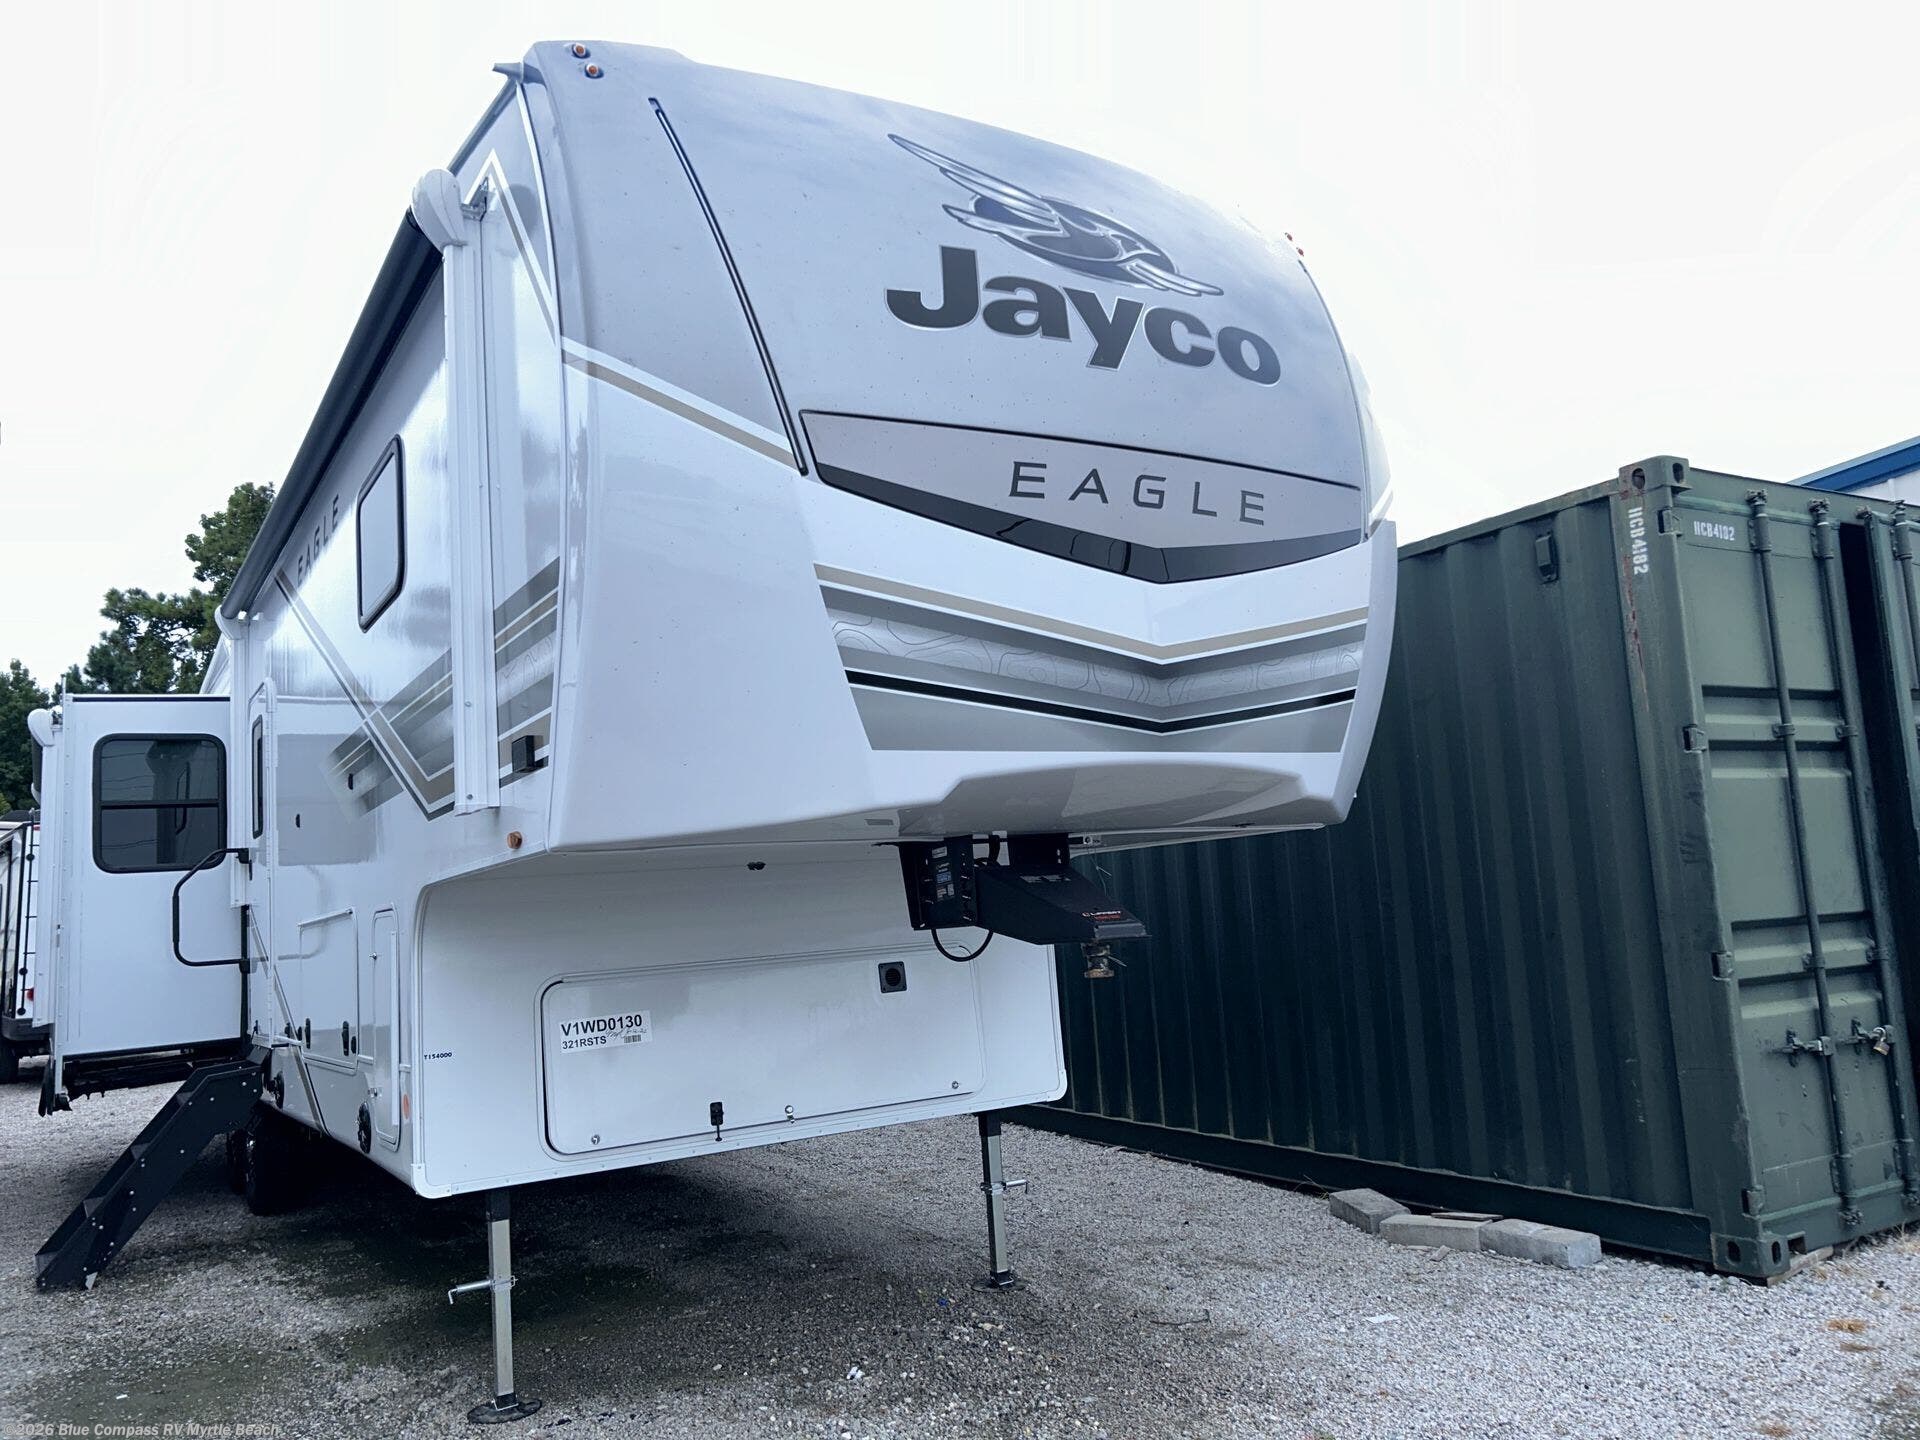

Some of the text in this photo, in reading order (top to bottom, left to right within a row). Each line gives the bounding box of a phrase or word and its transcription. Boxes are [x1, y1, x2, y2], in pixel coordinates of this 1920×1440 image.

[885, 245, 1281, 384] Jayco
[1009, 461, 1265, 526] EAGLE
[297, 493, 339, 587] EAGLE
[561, 1014, 643, 1036] V1WD0130
[562, 1035, 607, 1050] 321RSTS
